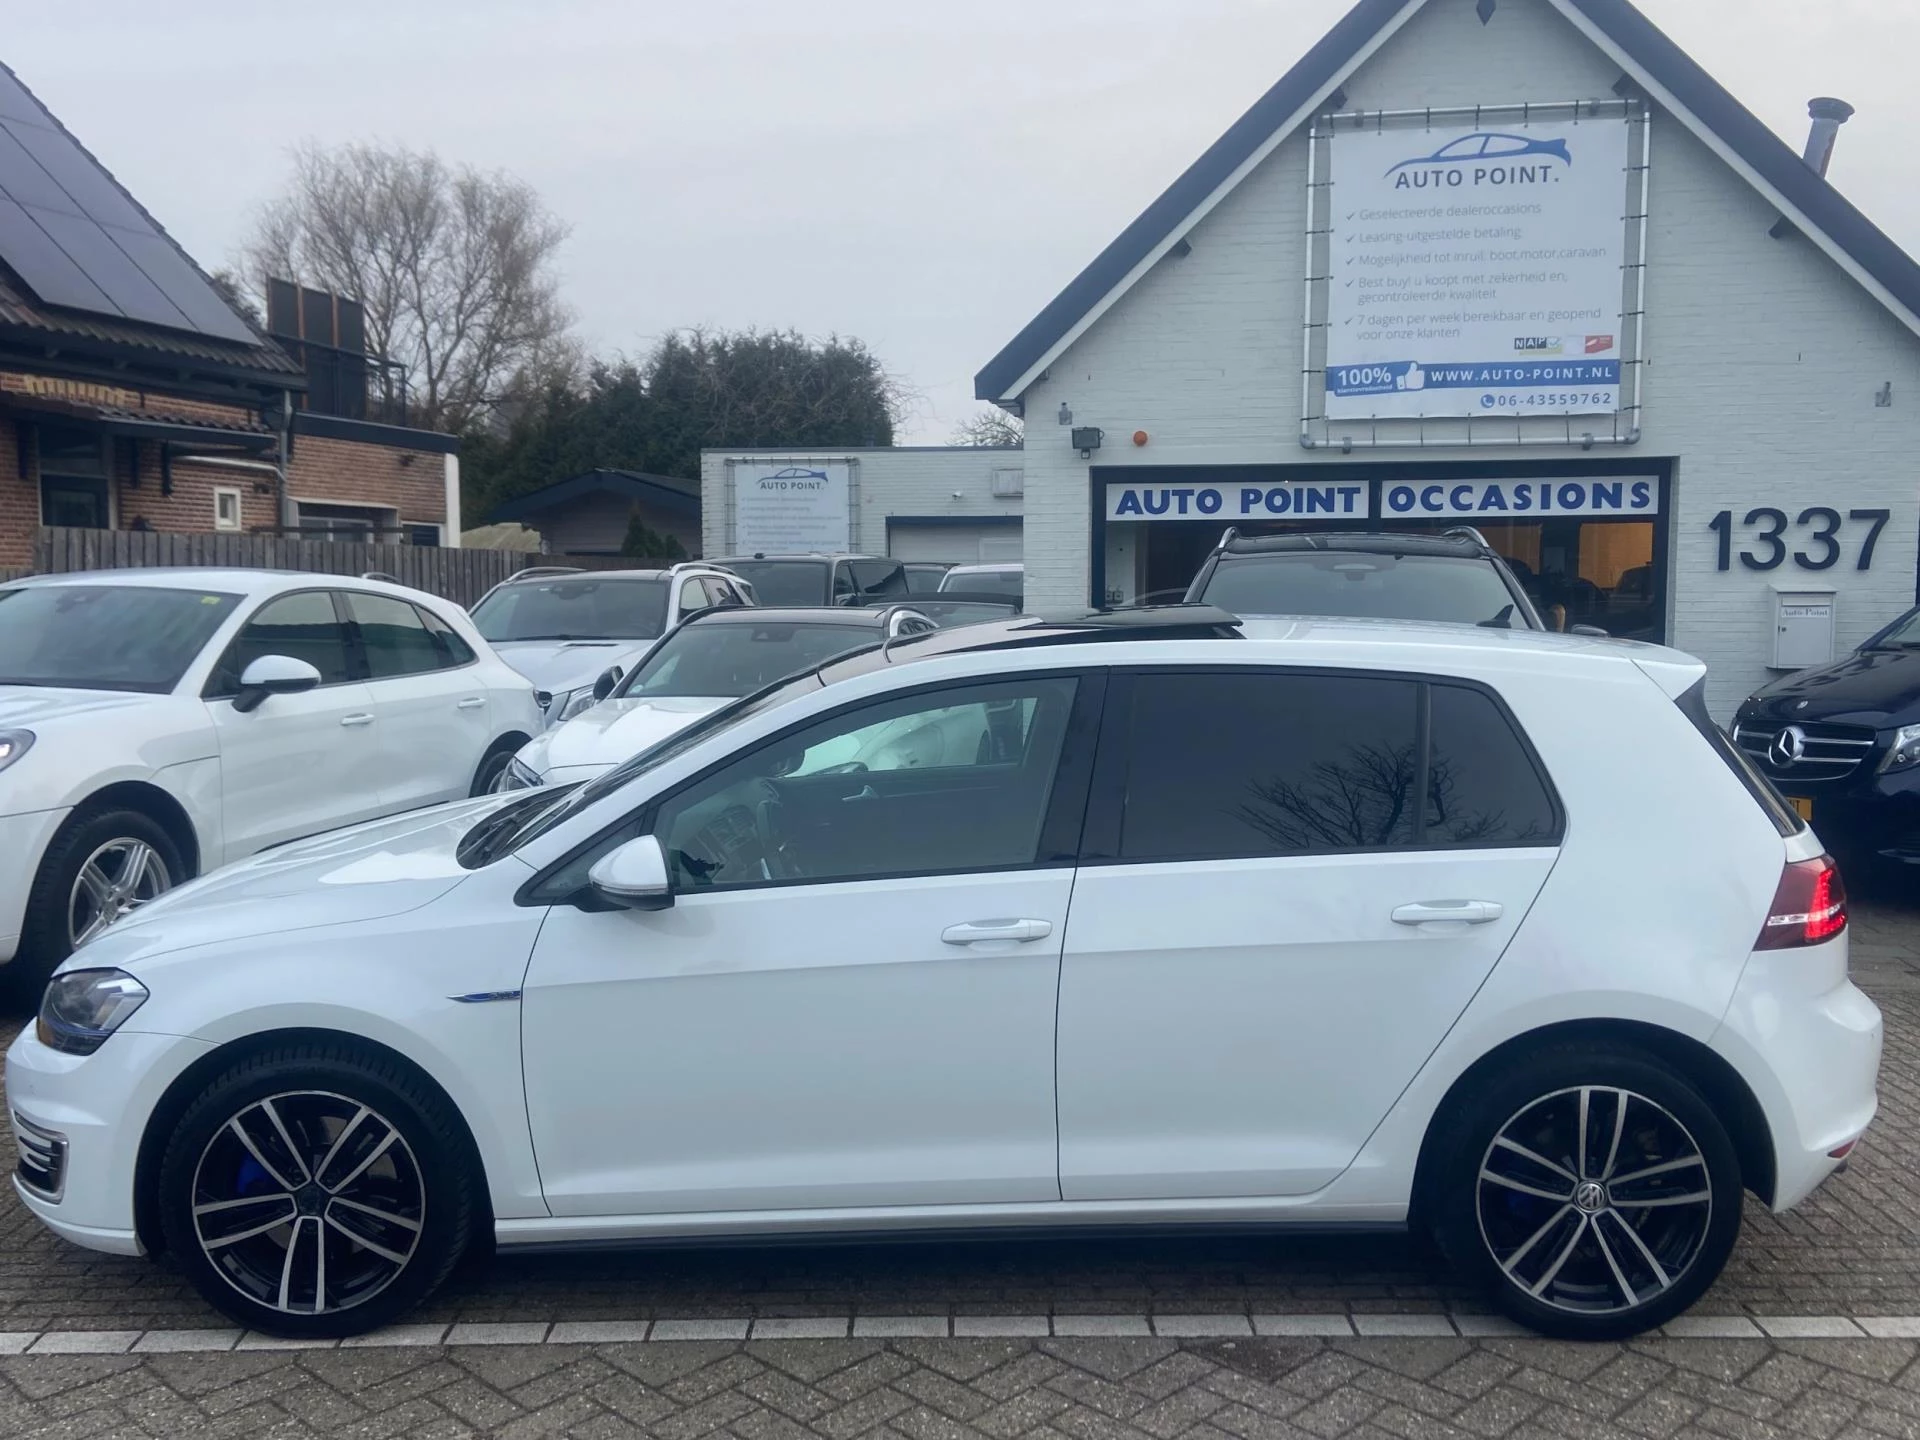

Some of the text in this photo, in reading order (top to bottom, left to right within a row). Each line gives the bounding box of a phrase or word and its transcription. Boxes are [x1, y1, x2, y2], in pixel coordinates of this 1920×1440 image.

[1395, 165, 1559, 189] AUTO POINT.
[1360, 203, 1541, 220] Geselecteerde dealeroccasions
[1359, 227, 1521, 244] Leasing uitgestelde betaling
[1359, 253, 1431, 267] Mogelijkheid
[1435, 252, 1450, 263] tot
[1359, 276, 1383, 288] Best
[1415, 278, 1422, 287] u
[1425, 275, 1459, 287] koopt
[1462, 274, 1484, 285] met
[1488, 271, 1546, 284] zekerheid
[1358, 288, 1496, 306] gecontroleerde kwaliteit
[1358, 308, 1602, 328] 7 dagen per week bereikbaar en geopend
[1357, 327, 1460, 340] voor onze klanten
[1514, 337, 1547, 349] NAP
[1338, 367, 1392, 386] 100%
[1431, 366, 1613, 382] WWW.AUTO-POINT.NL
[1498, 392, 1612, 407] 06-43559762
[760, 481, 787, 490] AUTO
[1115, 486, 1361, 515] AUTO POINT
[1388, 481, 1651, 513] OCCASIONS
[1708, 507, 1891, 571] 1337
[1783, 607, 1828, 617] Auto Point
